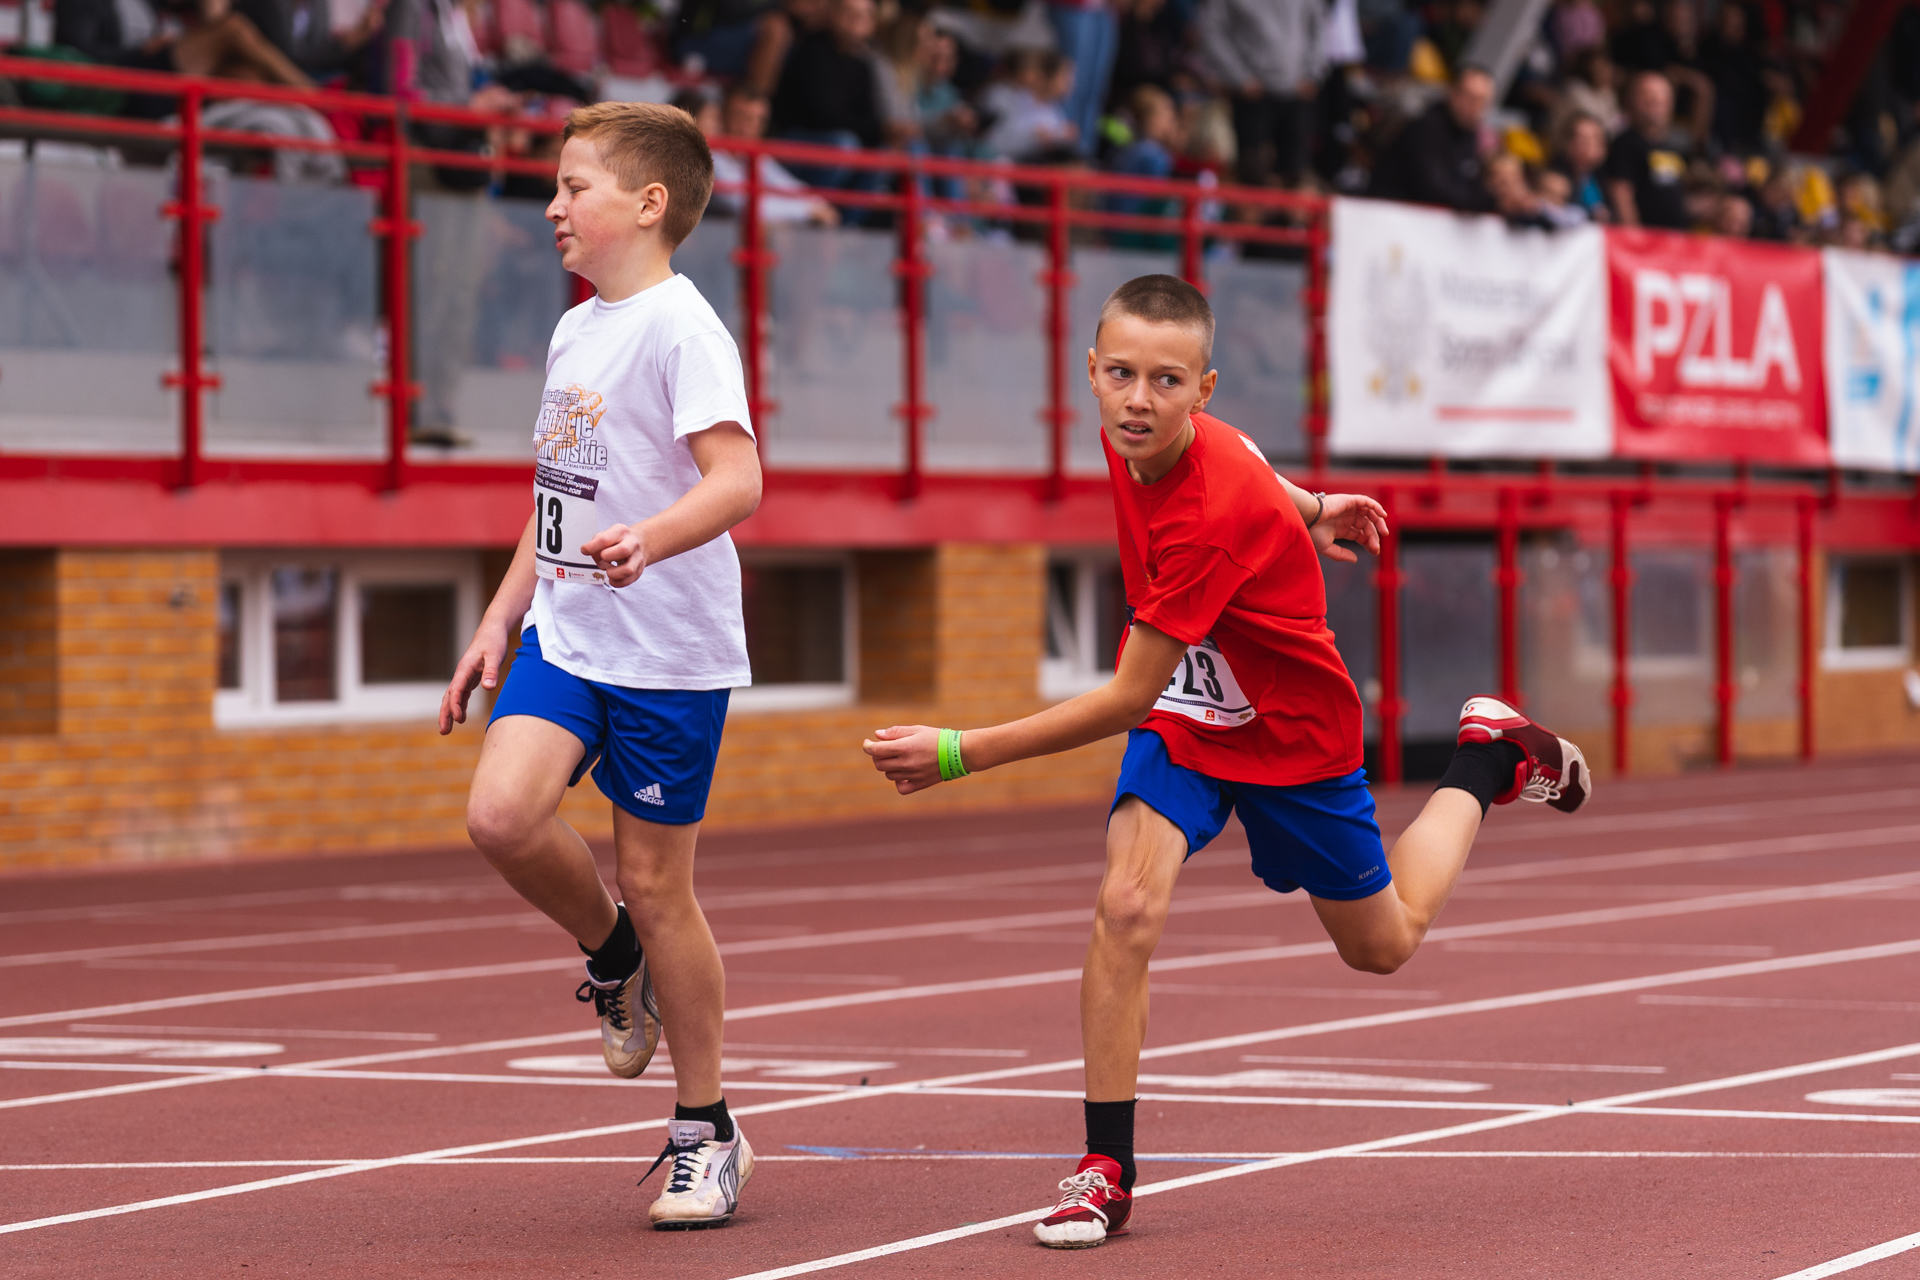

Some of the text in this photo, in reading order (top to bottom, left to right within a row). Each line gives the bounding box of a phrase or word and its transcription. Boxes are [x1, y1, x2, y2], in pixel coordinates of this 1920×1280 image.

[1632, 268, 1801, 393] PZLA
[537, 492, 562, 554] 13
[1164, 651, 1224, 702] 23
[634, 791, 665, 806] adidas
[1358, 865, 1380, 880] KIPSTA
